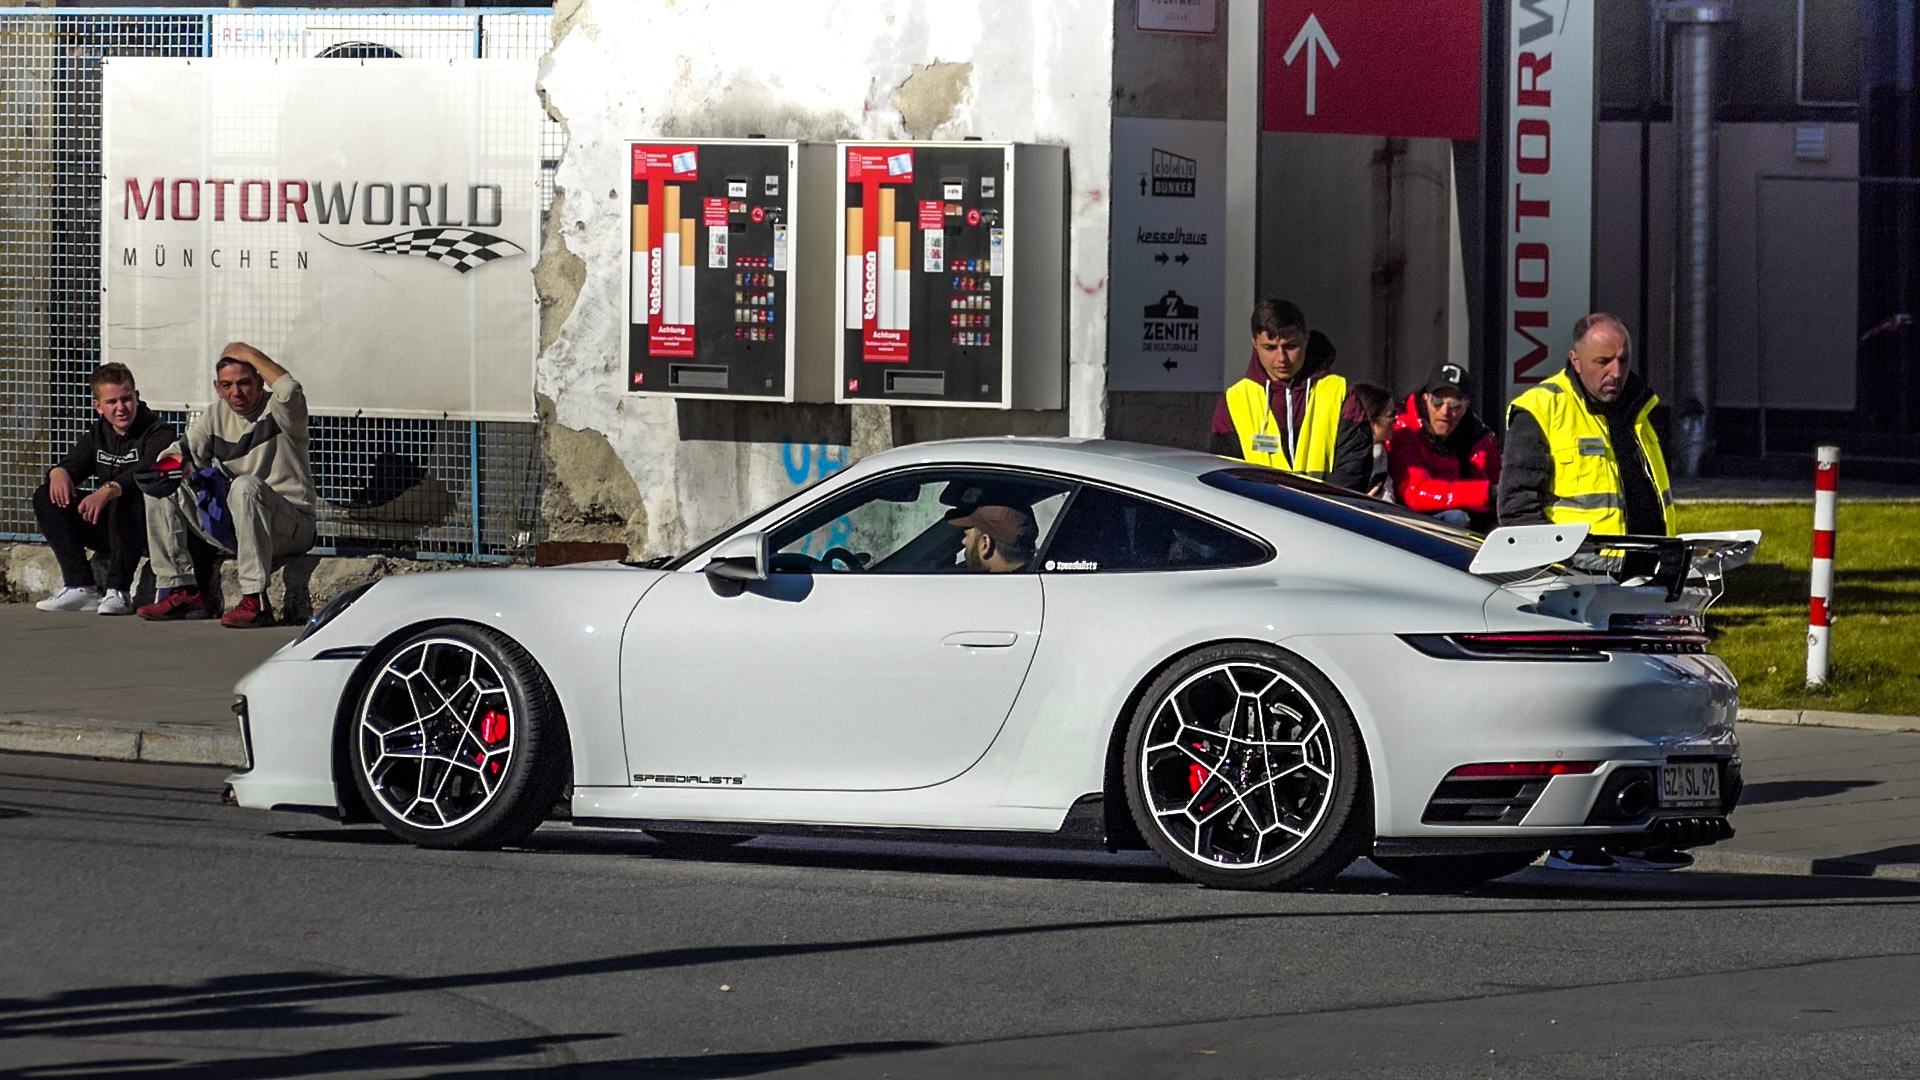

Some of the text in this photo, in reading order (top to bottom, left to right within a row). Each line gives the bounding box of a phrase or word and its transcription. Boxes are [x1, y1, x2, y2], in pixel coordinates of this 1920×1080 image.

[1155, 164, 1194, 176] KOHLE
[1155, 180, 1193, 194] BUNKER
[123, 176, 503, 228] MOTORWORLD
[1137, 225, 1208, 245] kesselhaus
[123, 244, 309, 270] MÜNCHEN
[649, 246, 662, 315] tabacon
[864, 250, 877, 320] tabacon
[658, 326, 685, 335] Achtung
[873, 331, 900, 340] Achtung
[1143, 321, 1199, 341] ZENITH
[633, 774, 743, 785] SPEEDIALISTS
[1663, 767, 1717, 796] GZ SL 92
